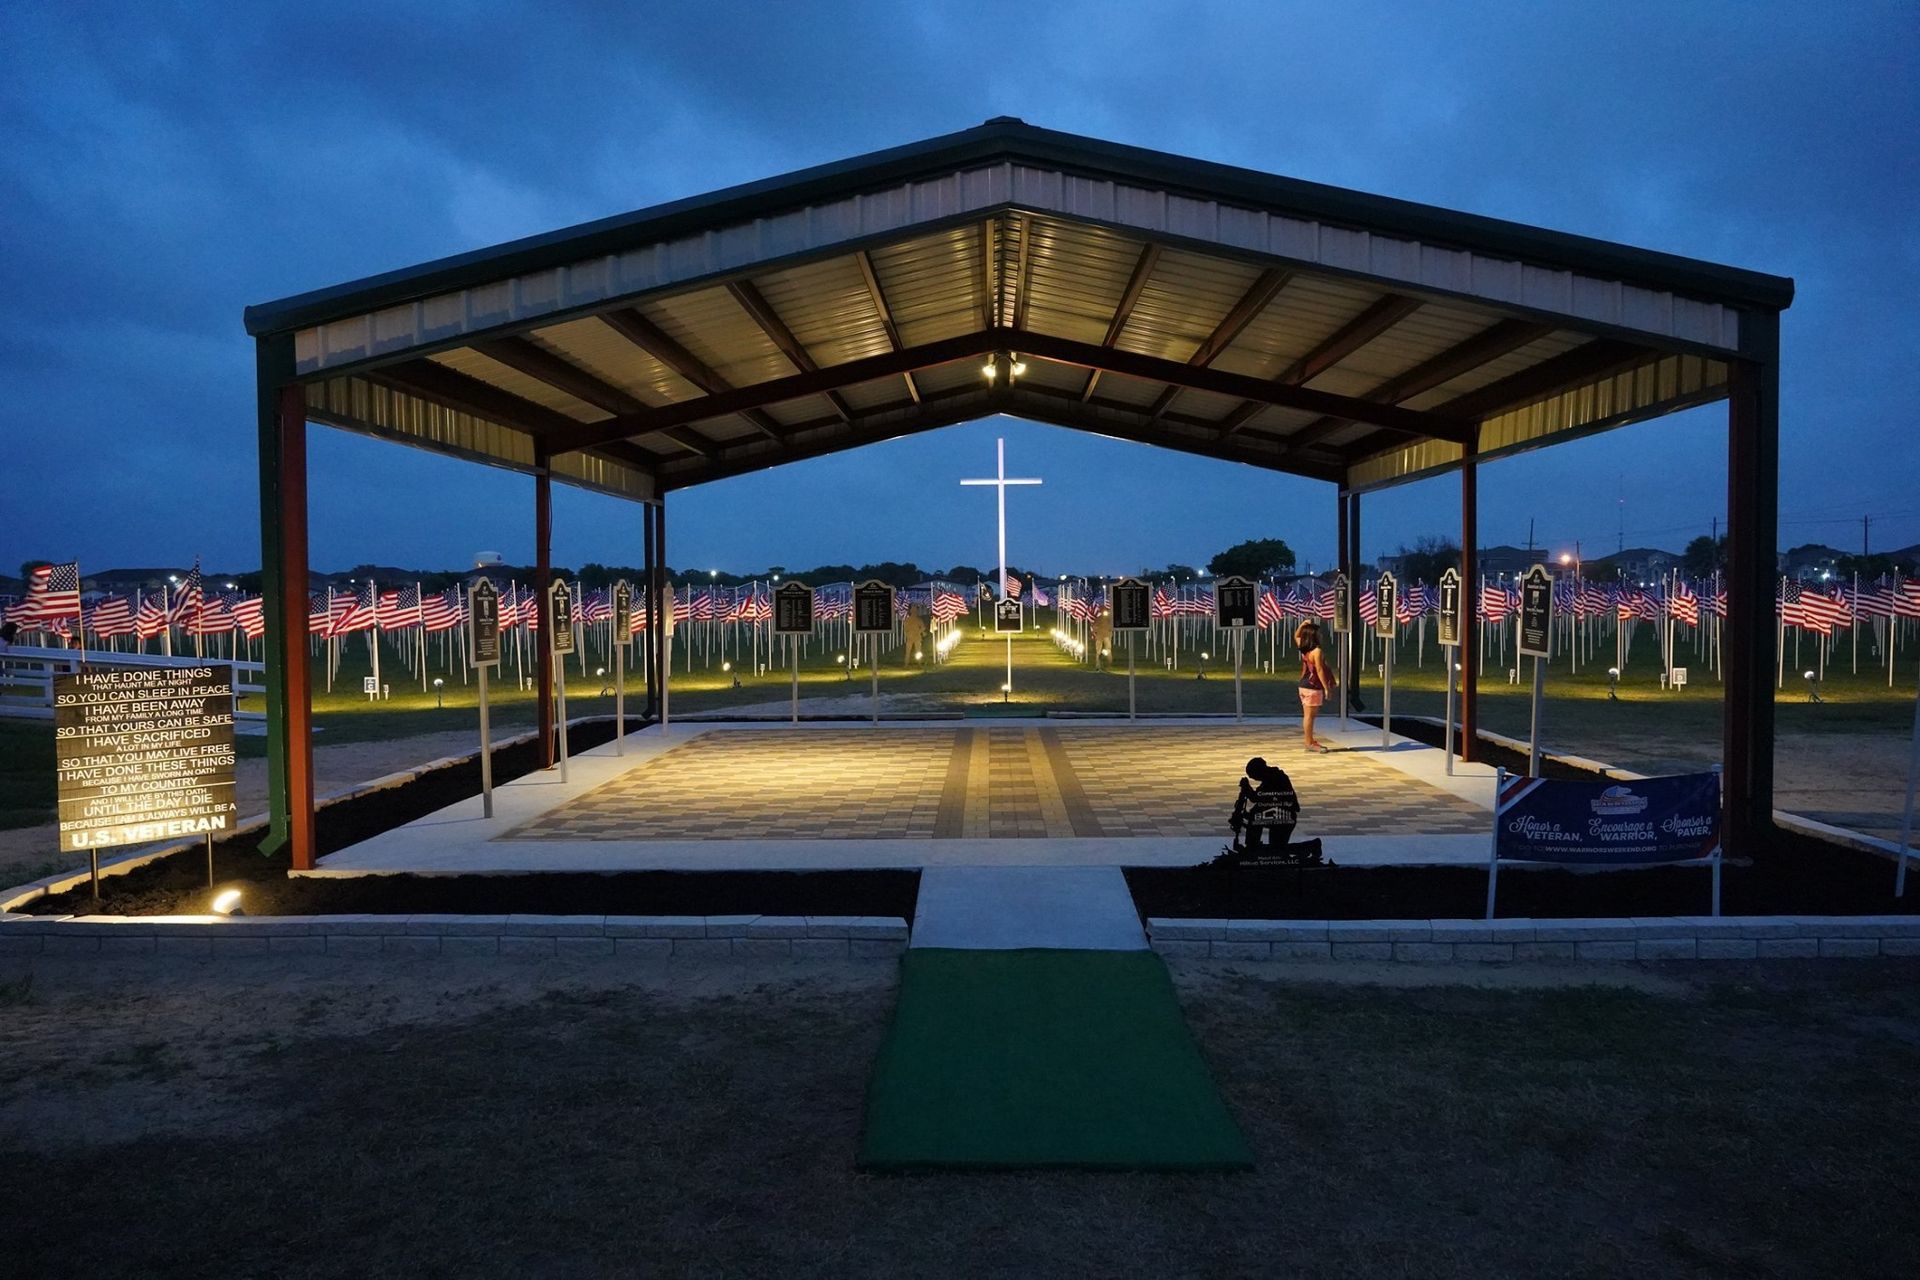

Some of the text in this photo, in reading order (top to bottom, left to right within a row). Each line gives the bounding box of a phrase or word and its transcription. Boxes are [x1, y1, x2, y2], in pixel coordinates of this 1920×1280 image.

[84, 672, 120, 684] HAVE
[124, 671, 161, 682] DONE
[164, 668, 212, 679] THINGS
[58, 685, 230, 704] SO YOU CAN SLEEP IN PEACE
[93, 704, 128, 715] HAVE
[132, 701, 168, 712] BEEN
[170, 698, 206, 710] AWAY
[57, 714, 232, 736] SO THAT YOURS CAN BE SAFE
[94, 735, 129, 747] HAVE
[134, 728, 211, 743] SACRIFICED
[62, 744, 230, 768] SO THAT YOU MAY LIVE FREE
[67, 769, 102, 781] HAVE
[106, 764, 143, 776] DONE
[146, 760, 187, 772] THESE
[190, 756, 235, 767] THINGS
[82, 777, 121, 786] BECAUSE
[152, 771, 181, 779] SWORN
[101, 777, 198, 794] TO MY COUNTRY
[84, 804, 120, 816] UNTIL
[126, 800, 152, 812] THE
[157, 797, 181, 809] DAY
[192, 794, 213, 804] DIE
[60, 817, 111, 831] BECAUSE
[147, 808, 188, 820] ALWAYS
[189, 806, 213, 815] WILL
[215, 804, 228, 812] BE
[1509, 816, 1551, 832] Honor
[1660, 813, 1712, 832] Sponsor a
[72, 815, 226, 847] U.S. VETERAN
[1588, 818, 1653, 836] Encourage a
[1600, 831, 1657, 841] WARRIOR,
[1677, 826, 1712, 837] PAVER,
[1526, 831, 1583, 842] VETERAN,
